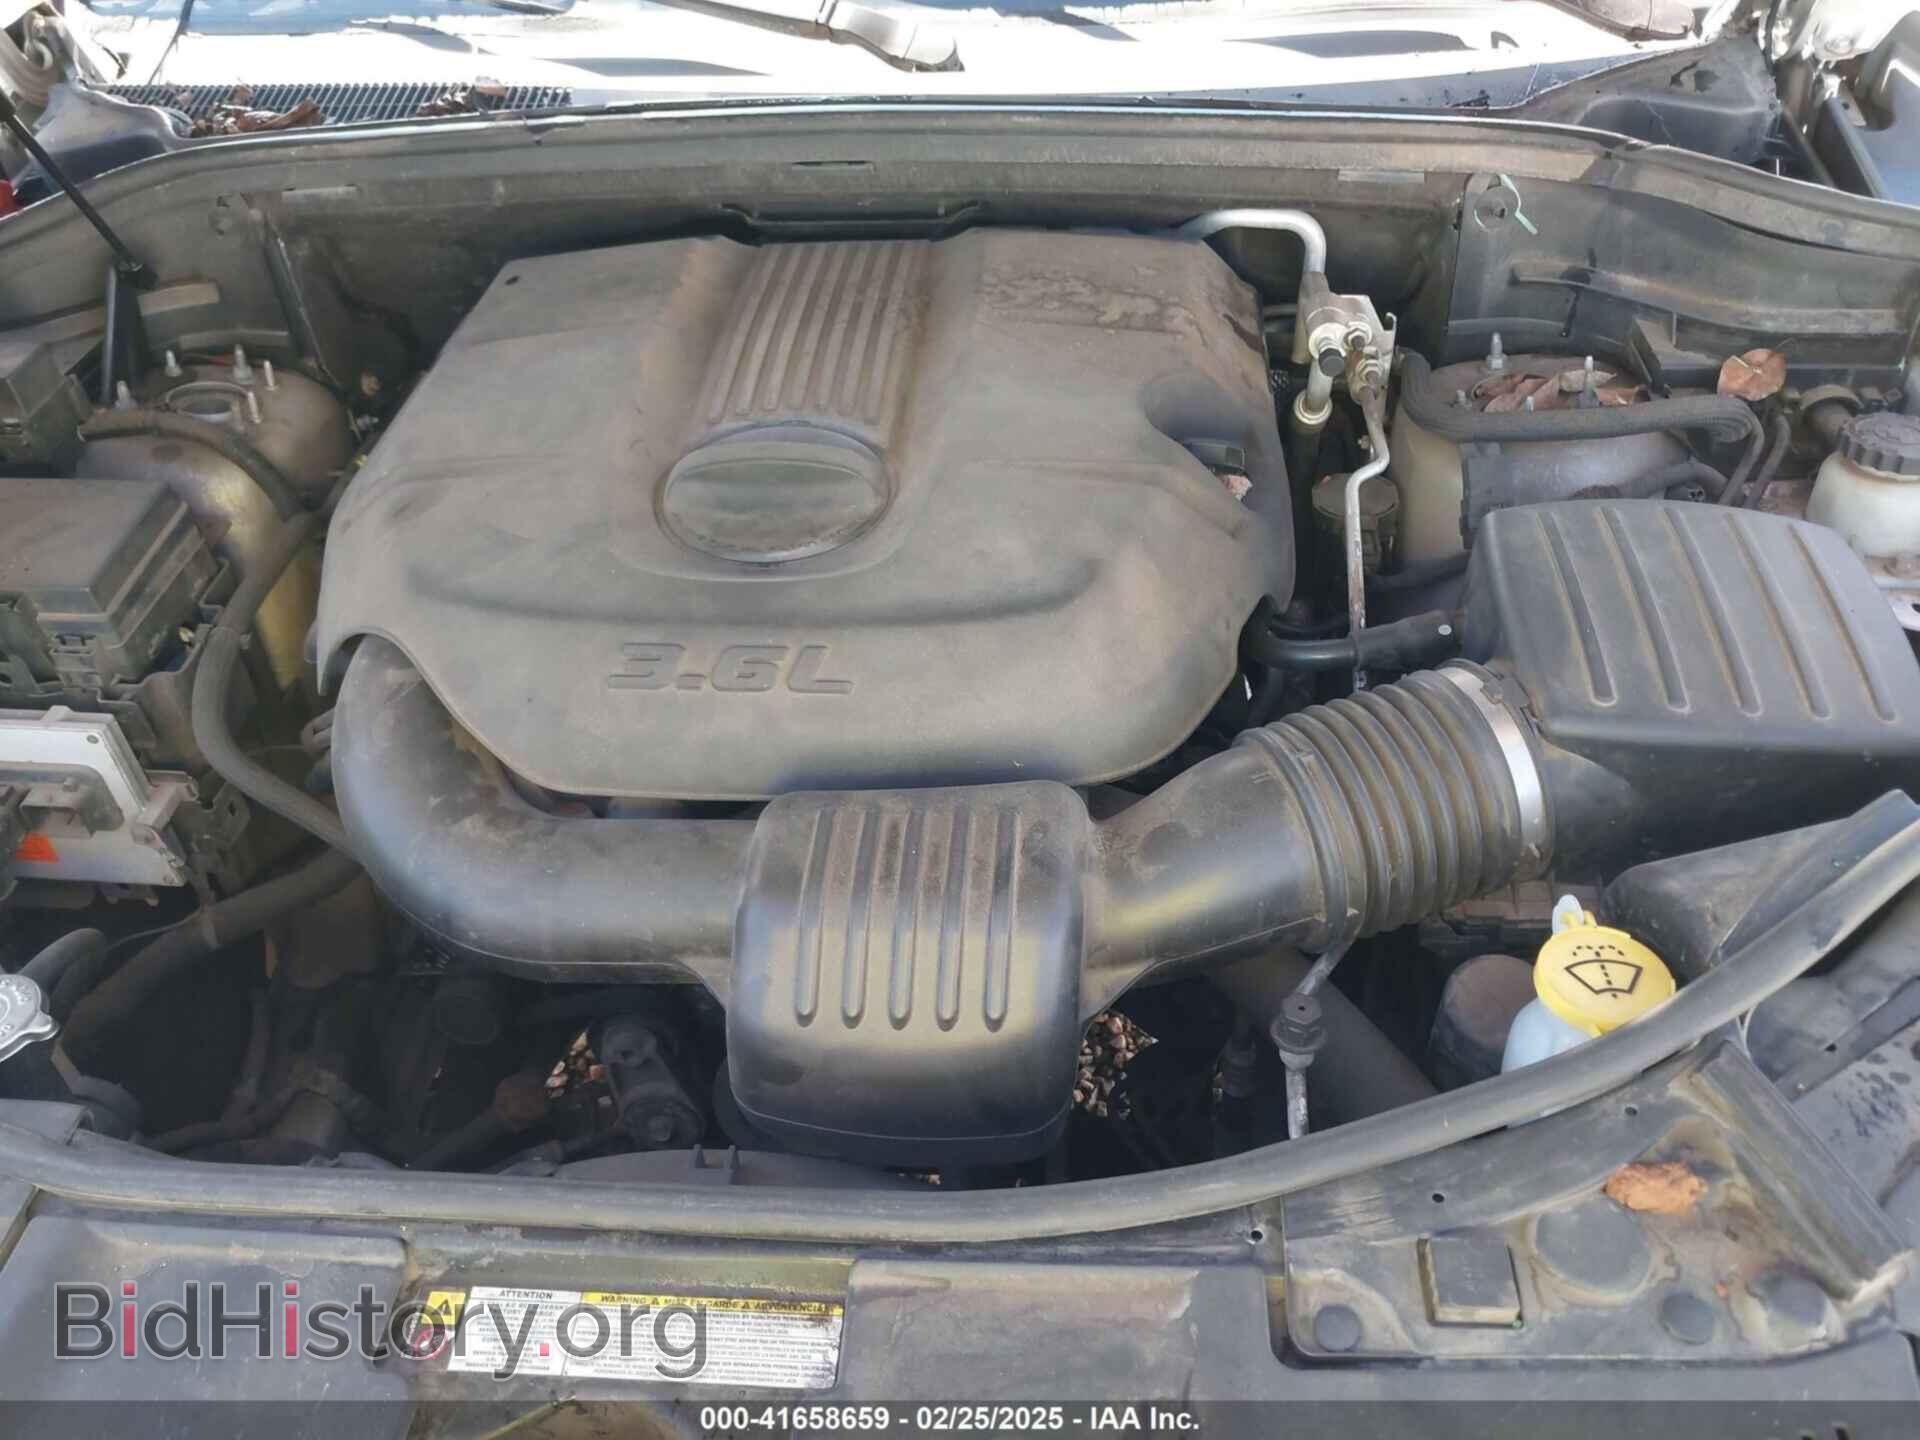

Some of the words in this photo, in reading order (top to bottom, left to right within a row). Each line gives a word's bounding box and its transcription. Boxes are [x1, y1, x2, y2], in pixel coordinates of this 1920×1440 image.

[607, 642, 855, 695] 3.6L
[498, 1289, 553, 1300] ATTENTION
[600, 1294, 647, 1304] WARNING
[707, 1299, 739, 1309] GARDE
